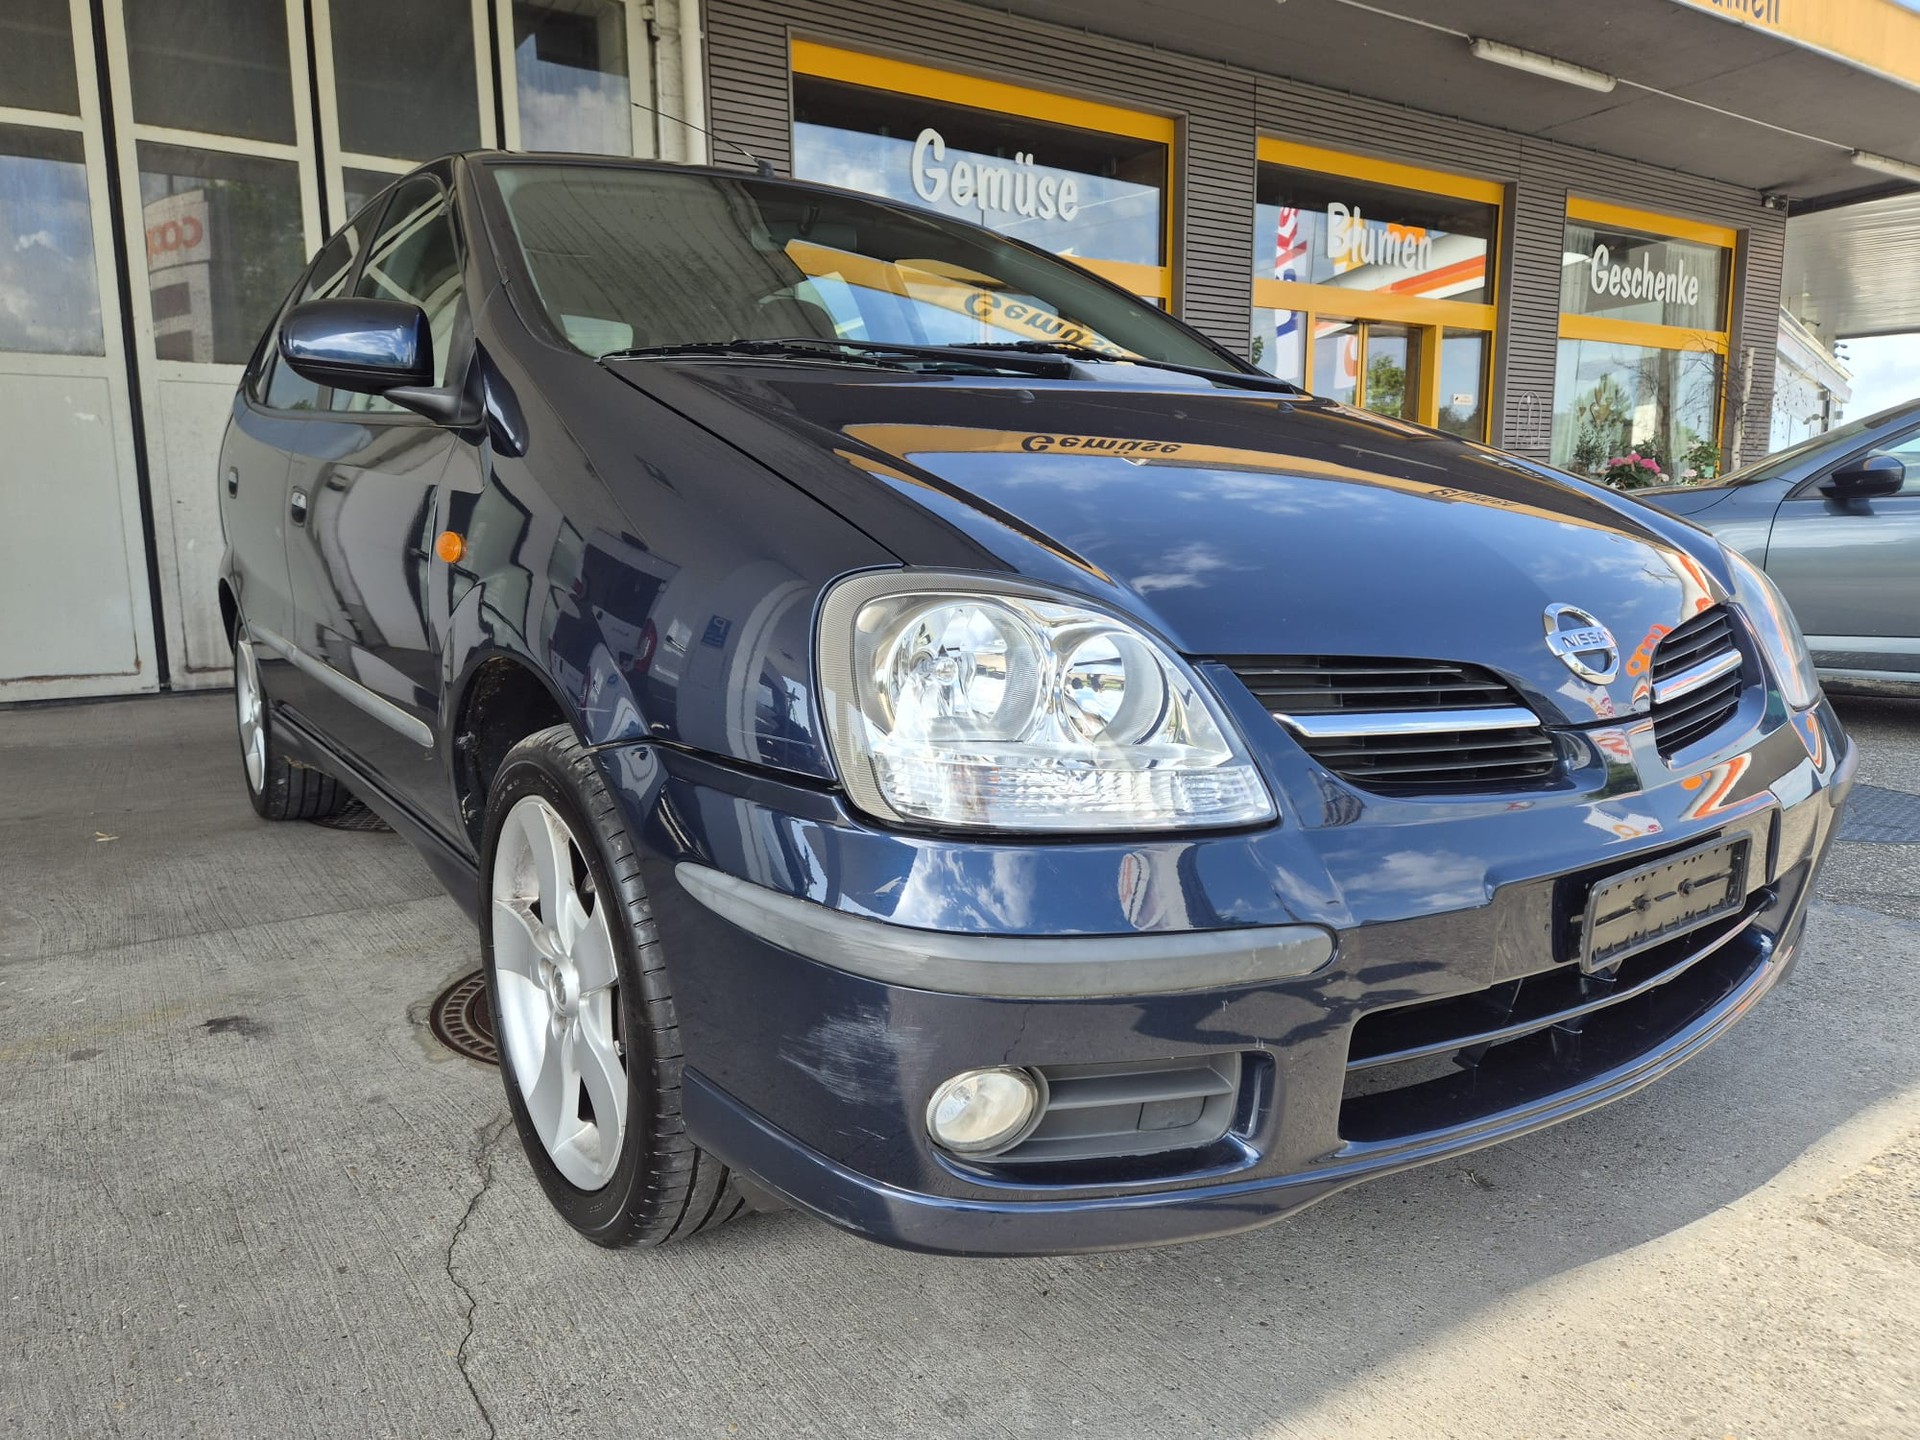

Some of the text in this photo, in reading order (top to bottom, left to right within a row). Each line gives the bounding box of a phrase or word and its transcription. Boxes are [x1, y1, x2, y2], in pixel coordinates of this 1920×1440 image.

[912, 128, 1079, 221] Gemüse
[1327, 202, 1432, 270] Blumen
[1591, 244, 1698, 306] Geschenke
